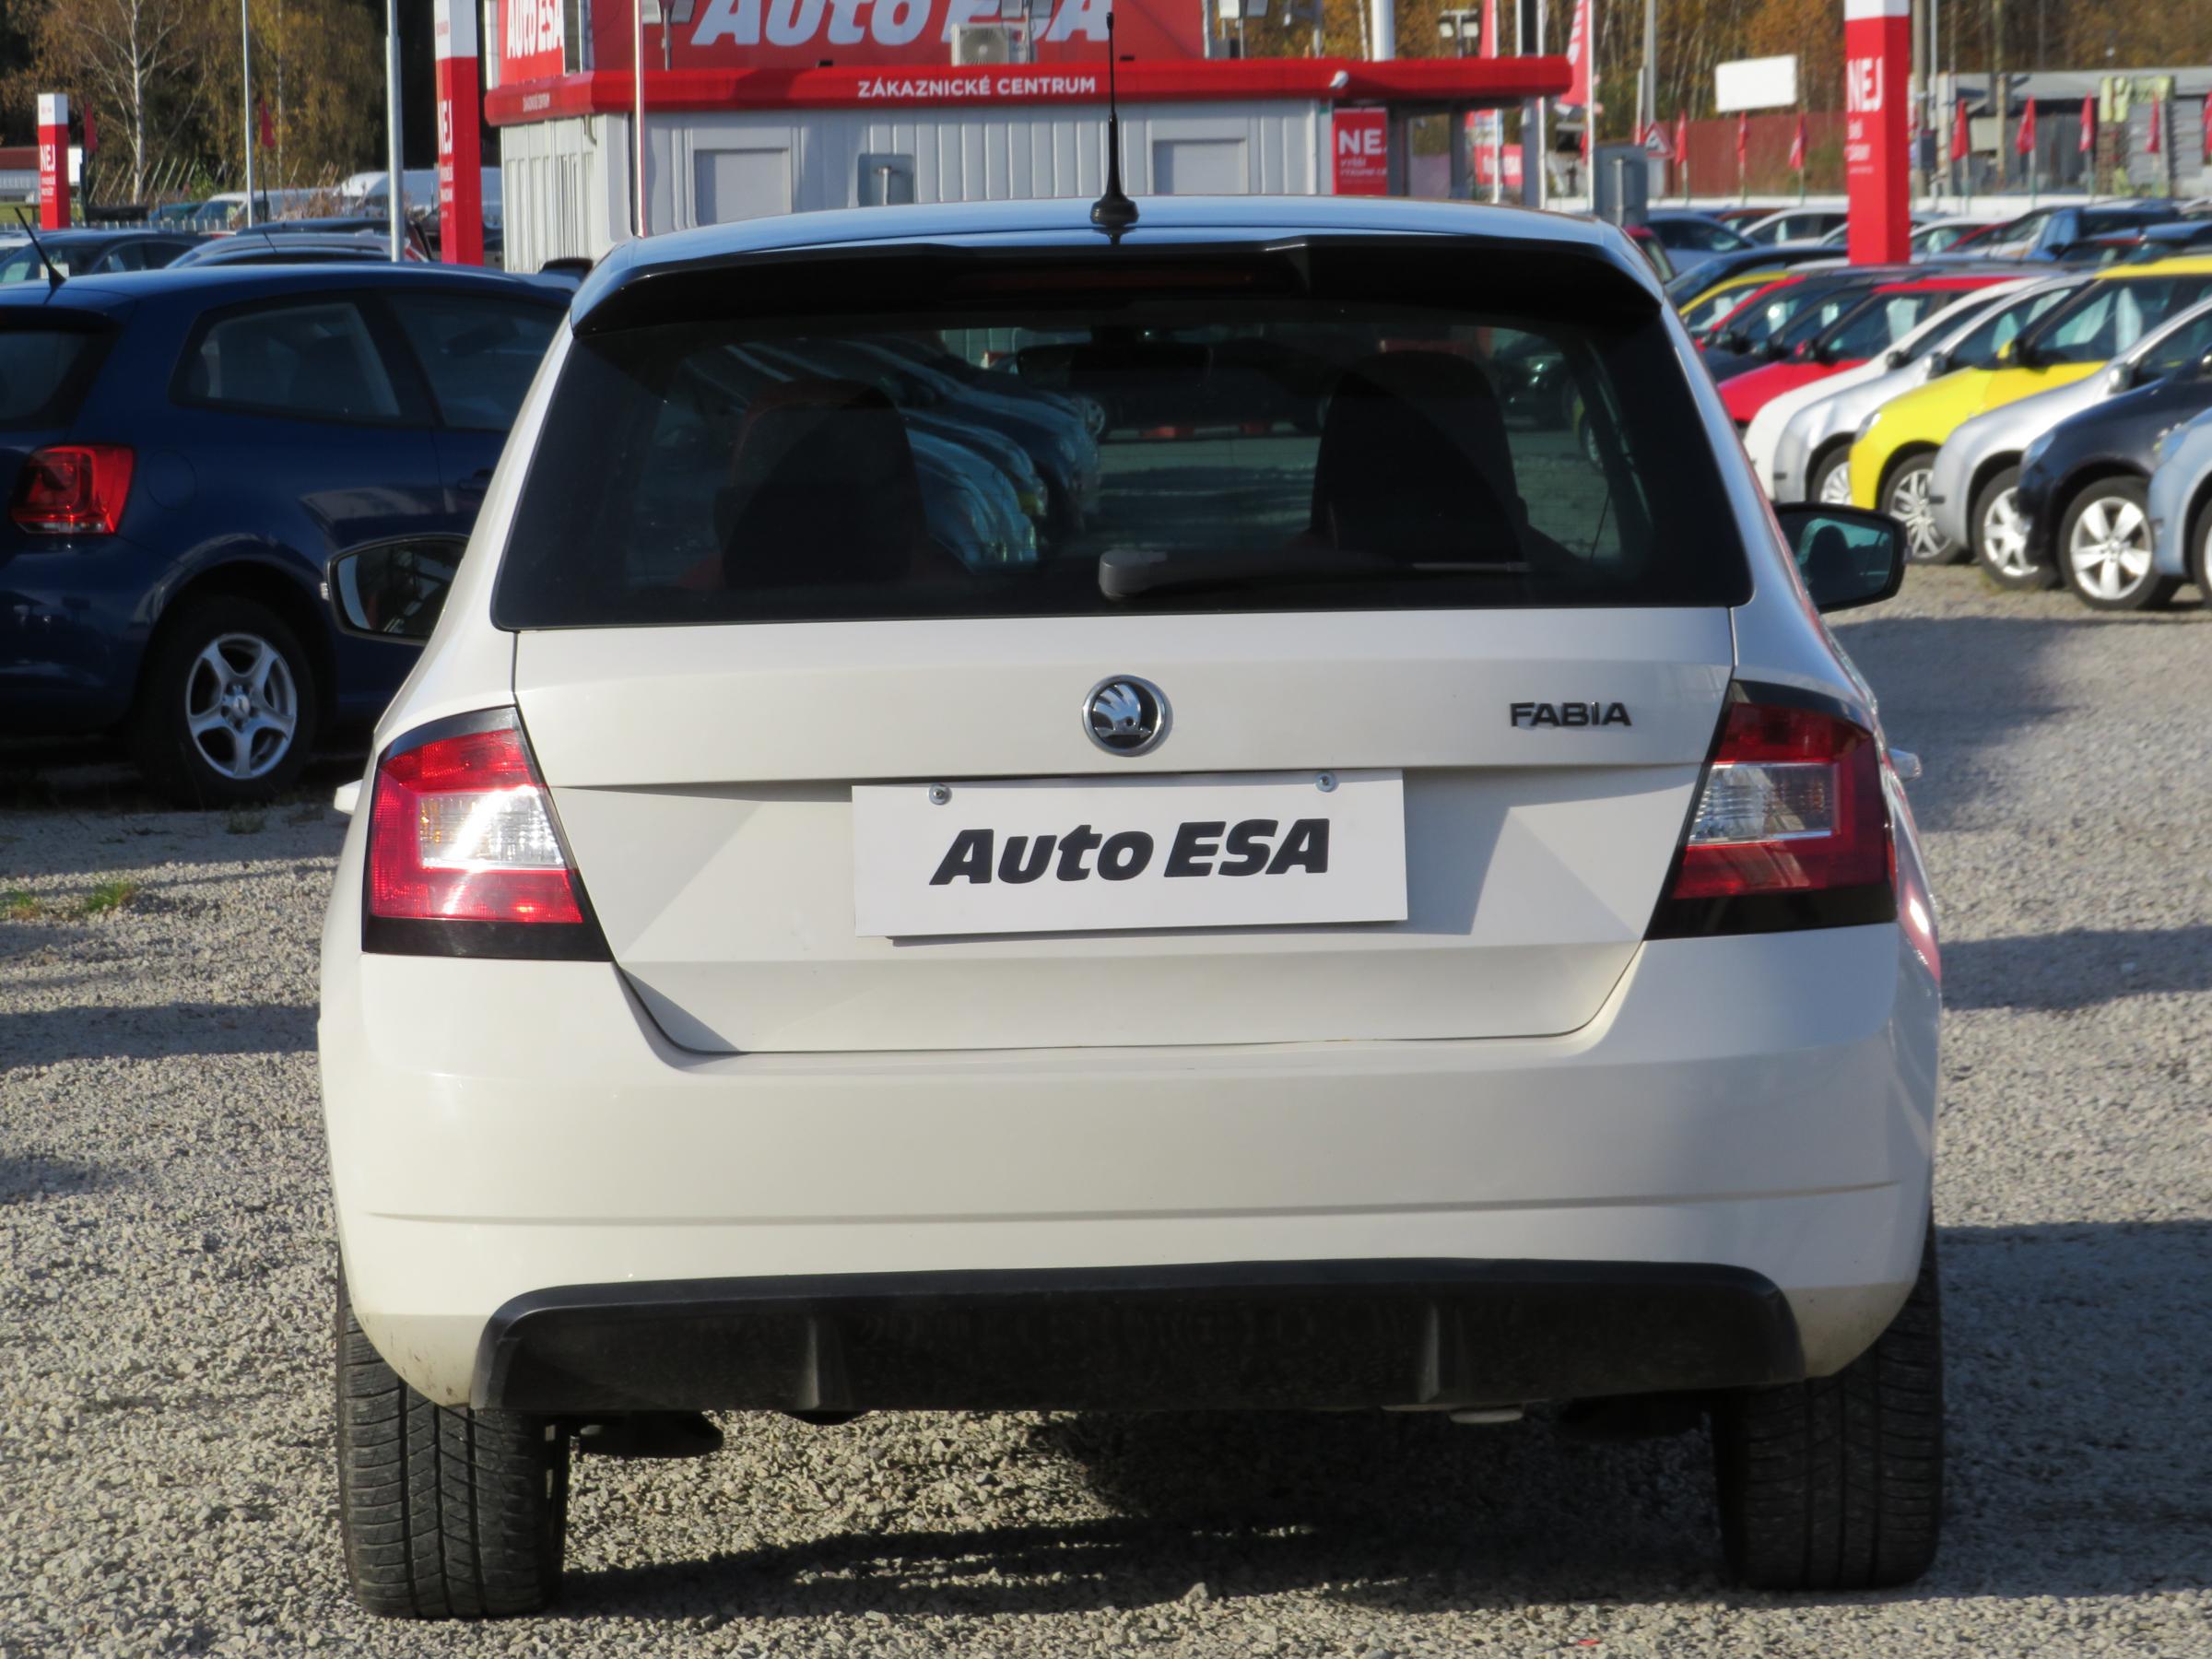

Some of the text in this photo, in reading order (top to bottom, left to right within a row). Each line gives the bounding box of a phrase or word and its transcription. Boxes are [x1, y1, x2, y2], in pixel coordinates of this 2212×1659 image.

[690, 0, 931, 45] Auto
[857, 76, 1096, 98] ZÁKAZNICKÉ CENTRUM
[1846, 56, 1884, 112] NEJ
[1338, 127, 1386, 155] NE
[1510, 701, 1632, 727] FABIA
[929, 818, 1330, 885] Auto ESA
